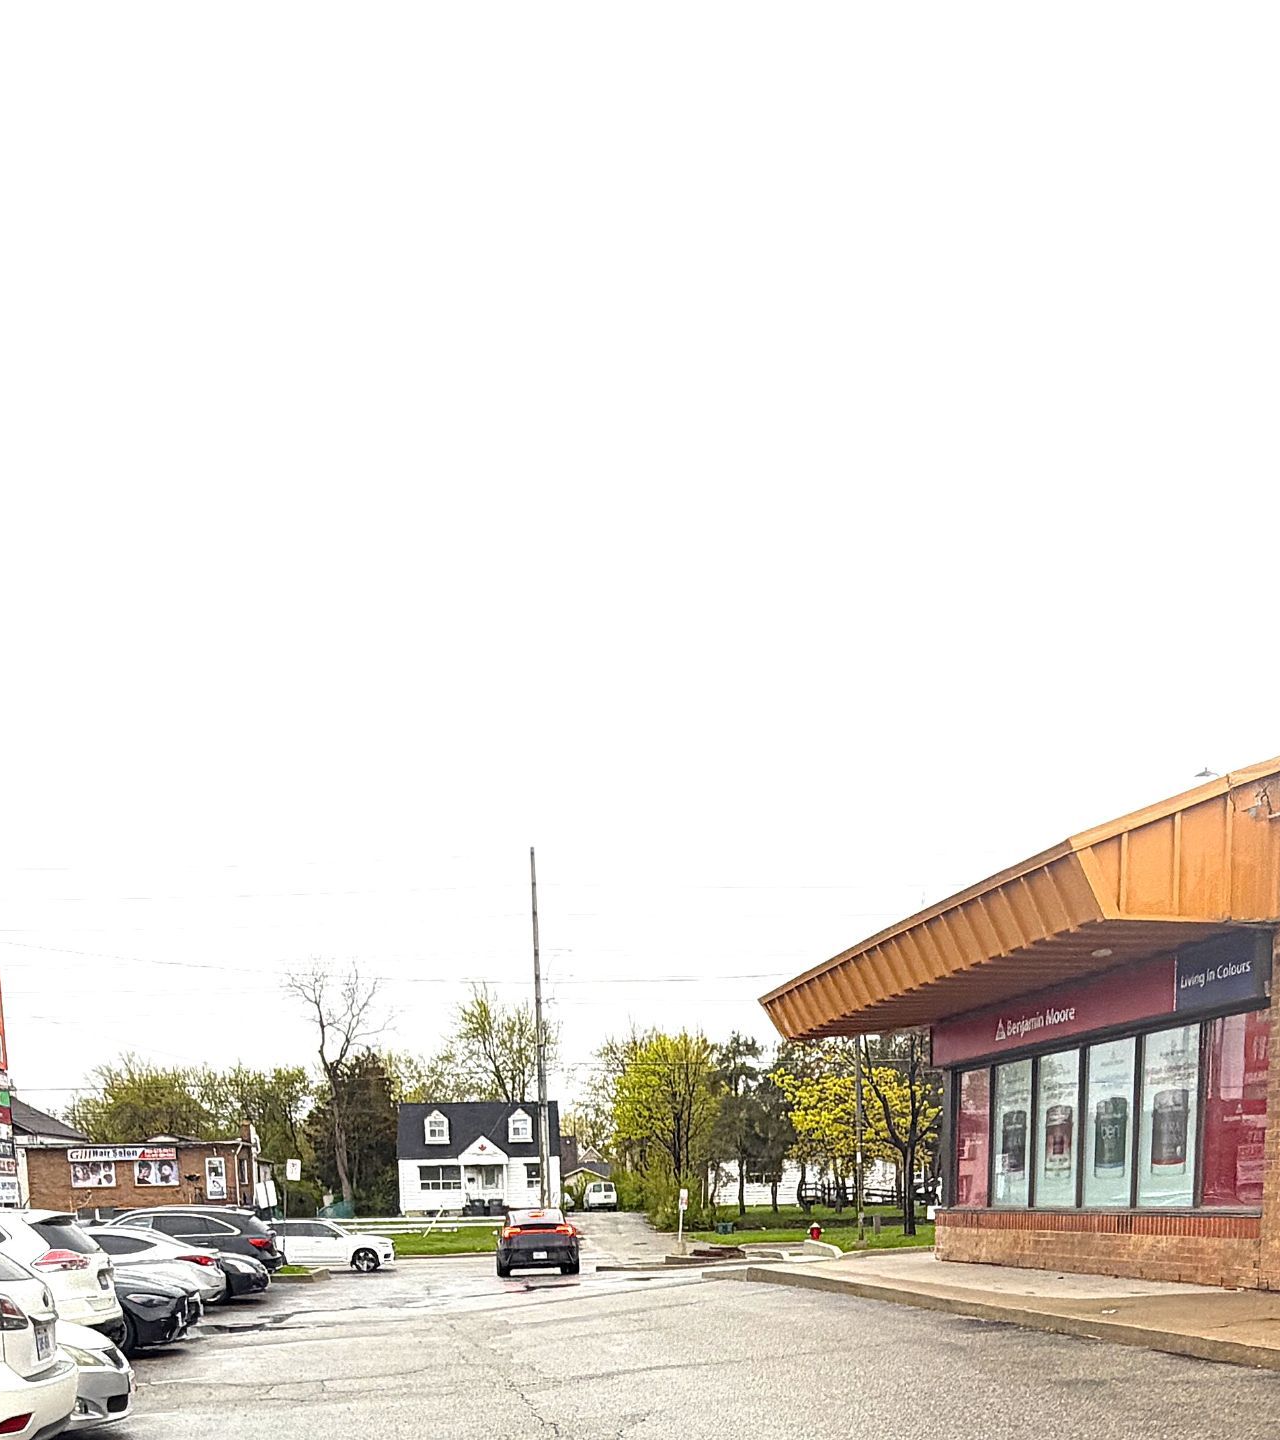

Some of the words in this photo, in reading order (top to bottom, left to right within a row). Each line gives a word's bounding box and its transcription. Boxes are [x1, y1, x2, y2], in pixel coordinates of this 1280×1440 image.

[1181, 974, 1205, 989] Living
[1217, 961, 1251, 979] Colours
[1006, 1011, 1044, 1038] Benjamin
[1045, 1007, 1076, 1026] Moore
[70, 1150, 91, 1160] Gill
[92, 1148, 111, 1158] Hair
[112, 1148, 138, 1158] Salon
